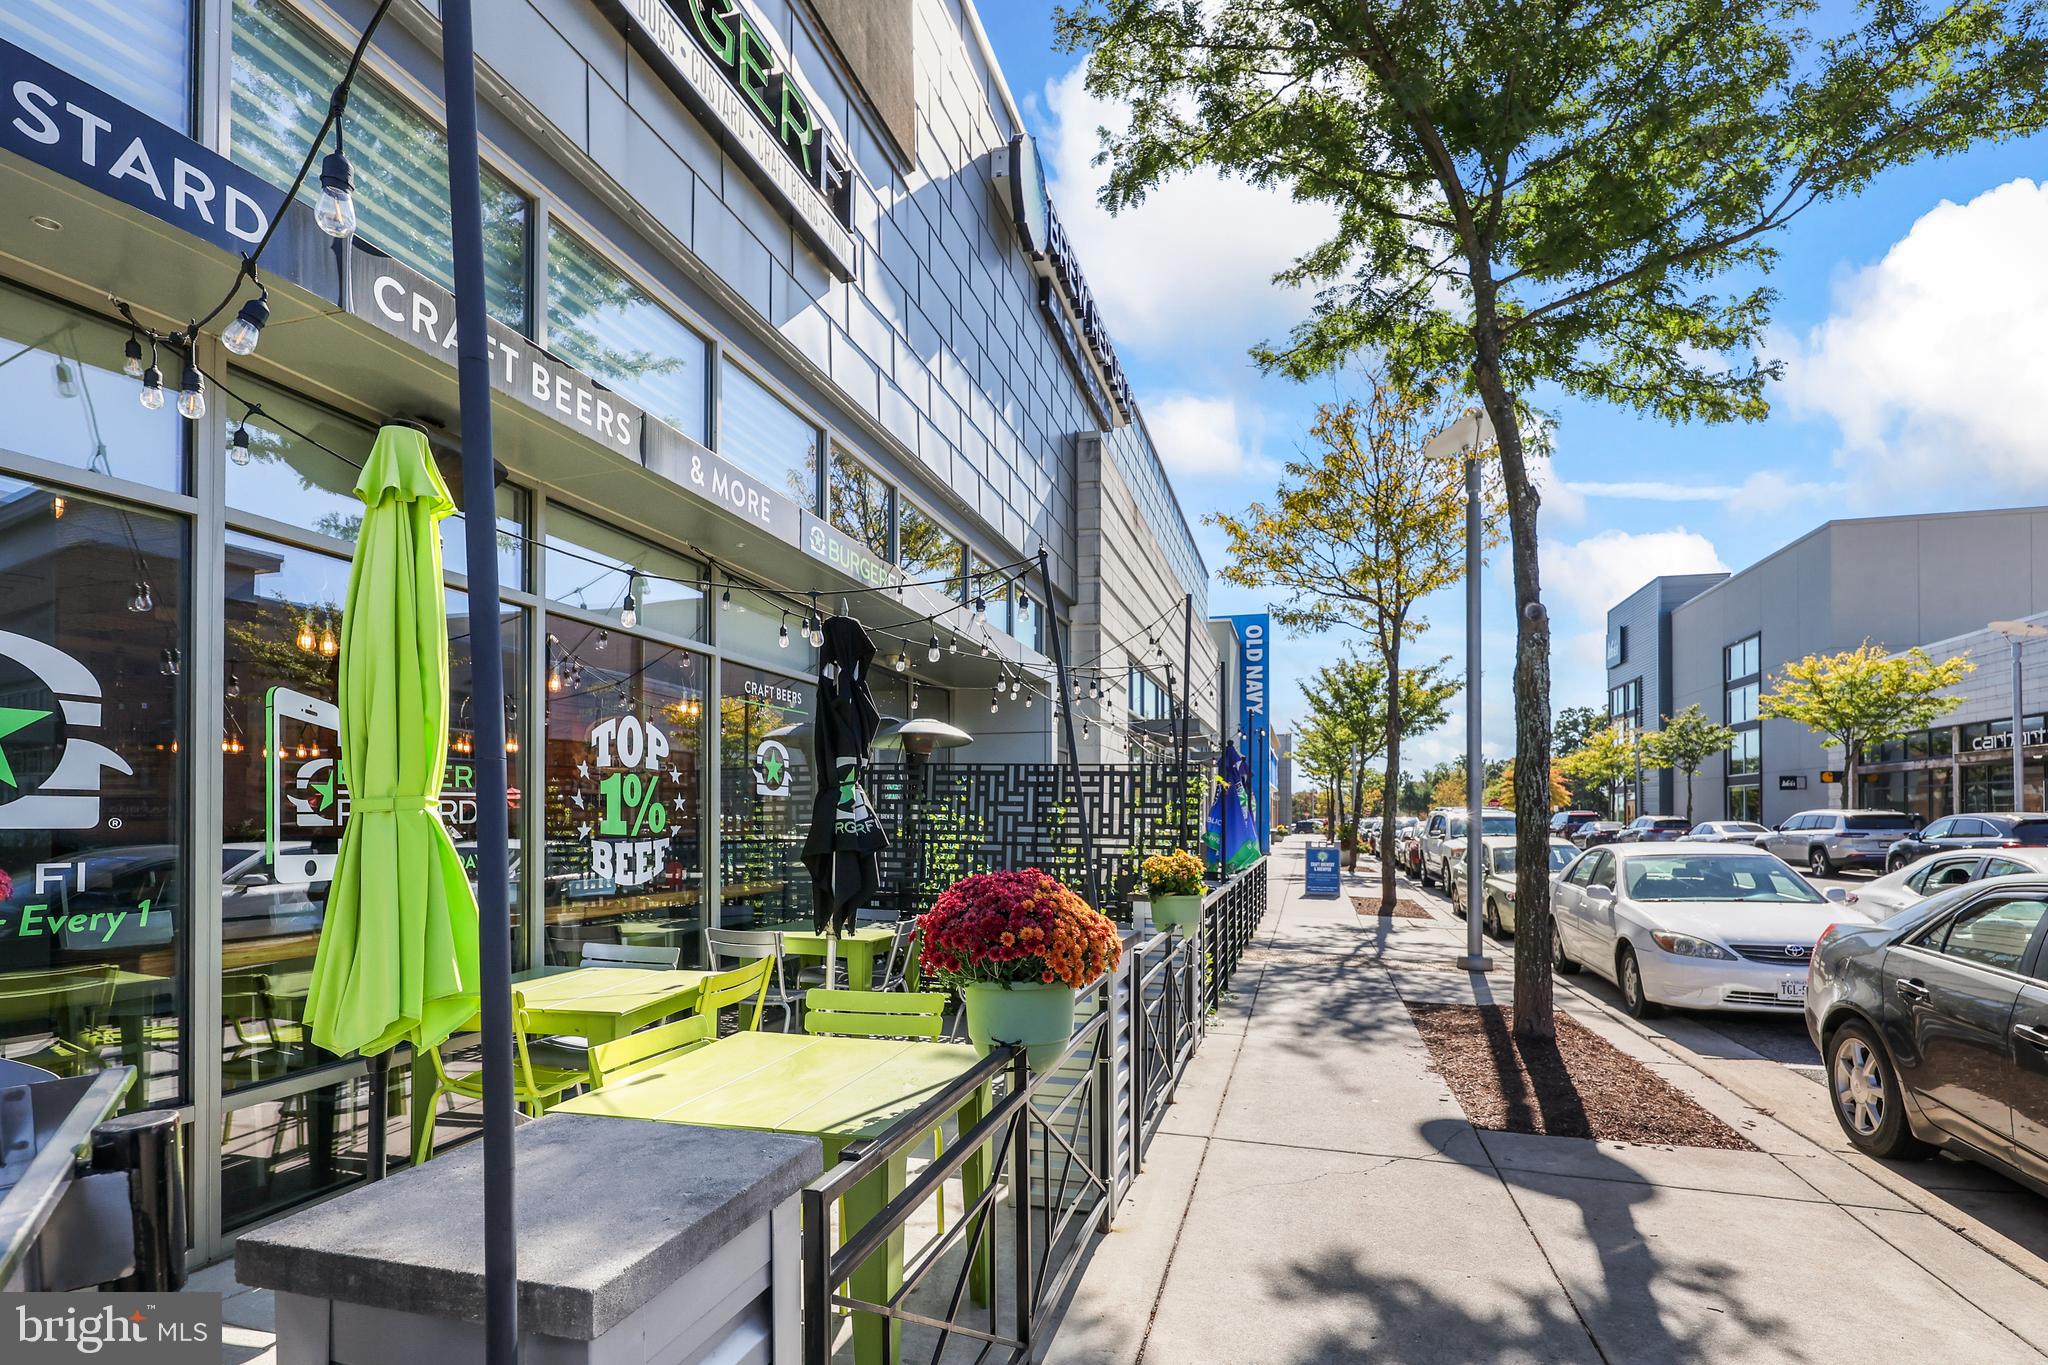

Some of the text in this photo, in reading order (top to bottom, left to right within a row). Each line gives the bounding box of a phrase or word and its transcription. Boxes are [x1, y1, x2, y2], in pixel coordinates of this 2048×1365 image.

[11, 79, 269, 244] STARD
[691, 48, 745, 138] CUSTARD
[757, 131, 788, 191] CRAFT
[791, 168, 818, 227] BEERS
[373, 275, 631, 445] CRT BEERS
[691, 455, 771, 524] & MORE
[744, 681, 802, 704] CRAFT BEERS
[1245, 624, 1264, 715] OLD NAVY
[591, 715, 670, 770] TOP
[600, 772, 667, 837] 1%
[36, 862, 86, 894] FI
[591, 837, 670, 886] BEEF
[19, 899, 151, 943] Every 1
